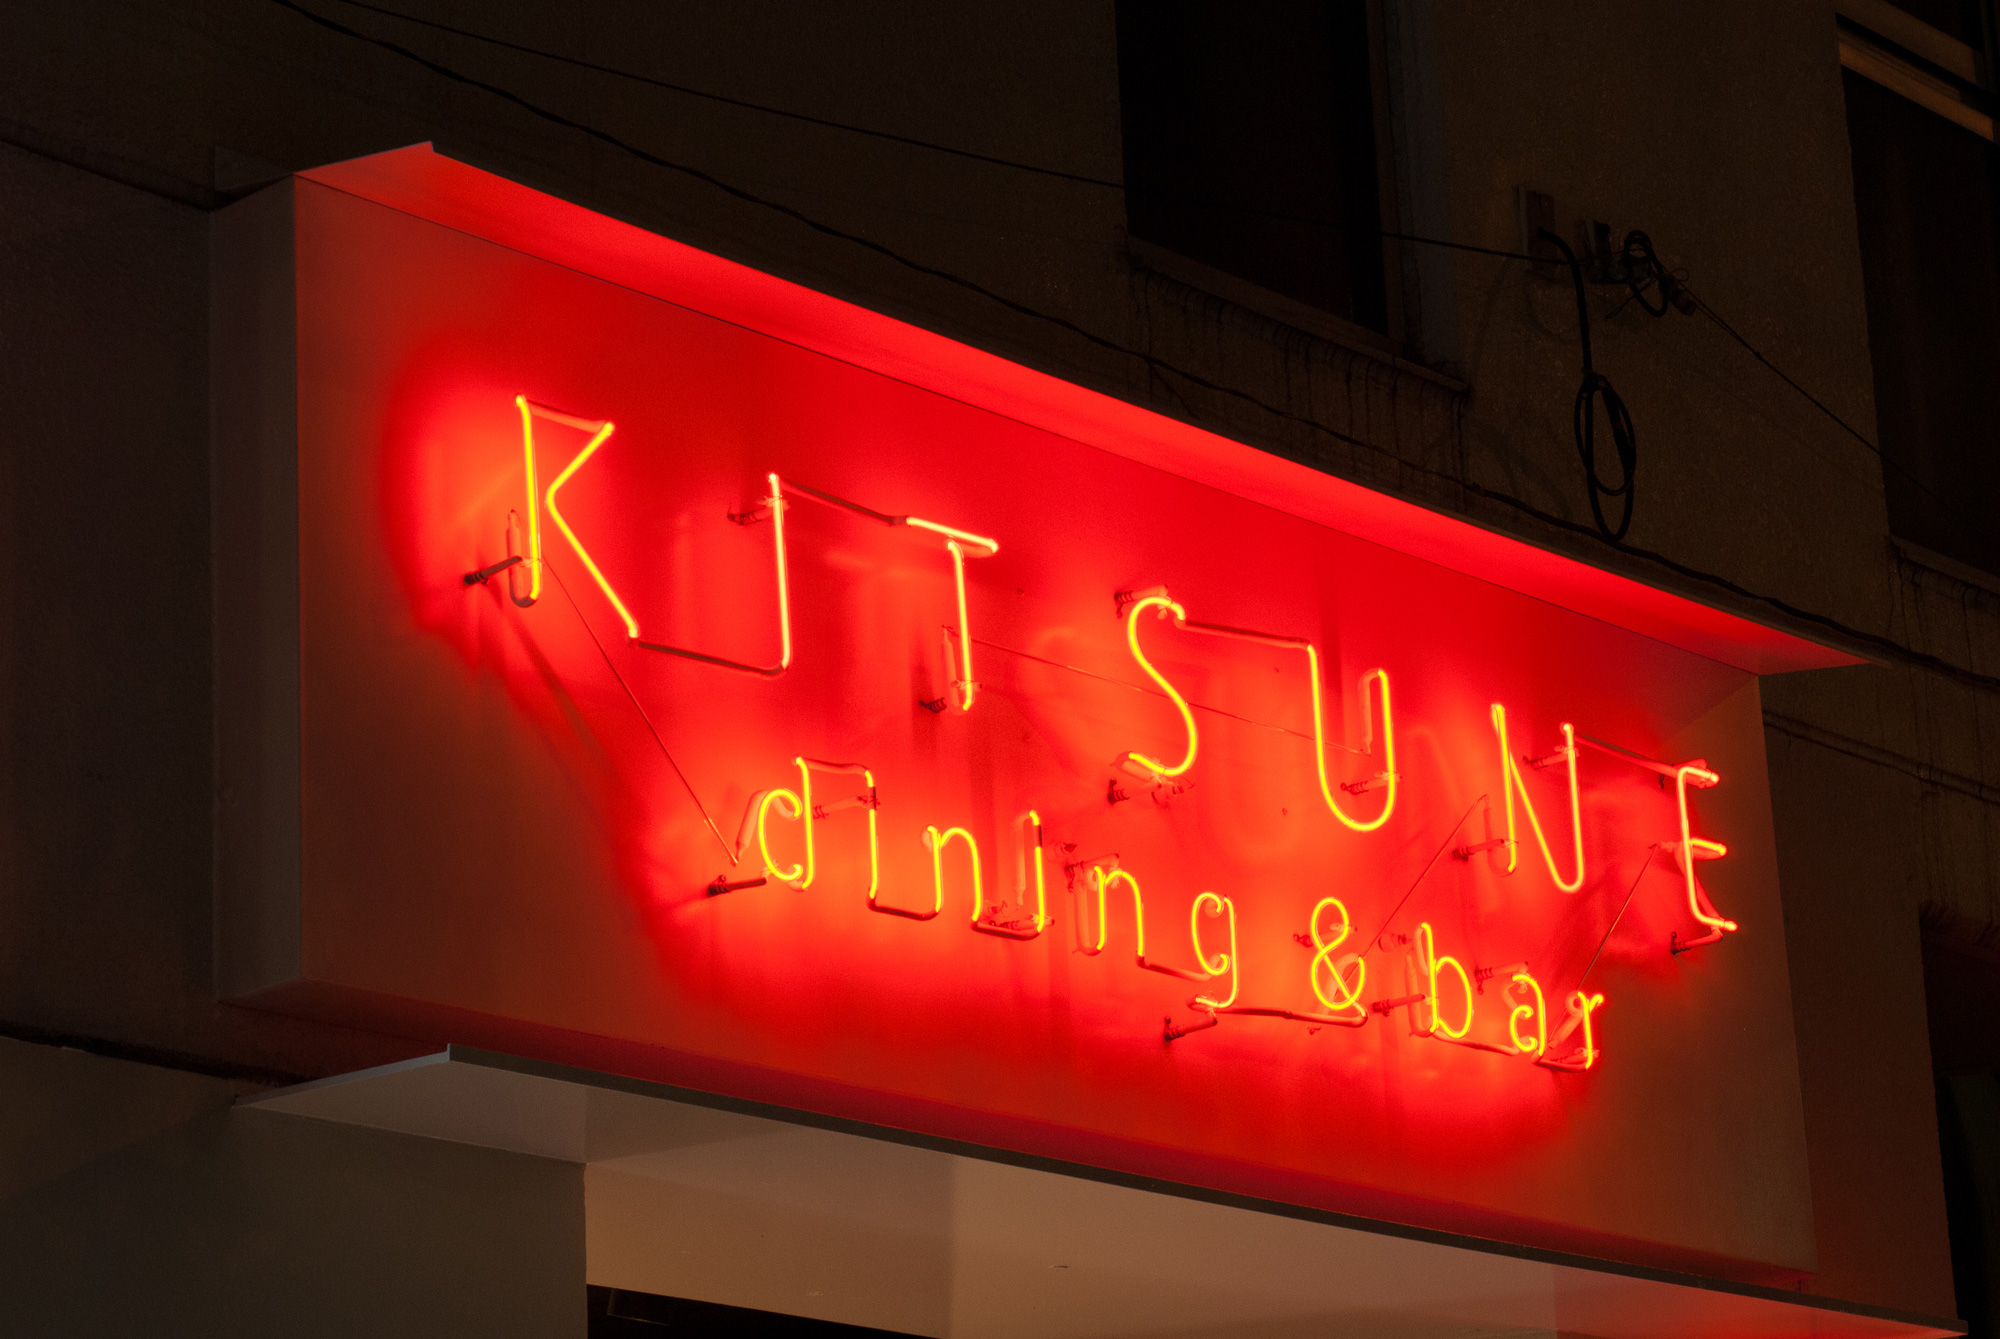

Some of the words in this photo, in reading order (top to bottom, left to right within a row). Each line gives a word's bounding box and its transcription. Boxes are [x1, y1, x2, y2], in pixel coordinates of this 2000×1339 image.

[514, 394, 1738, 931] KITSUNE
[757, 755, 1239, 1009] dining
[1311, 896, 1369, 1020] &
[1413, 921, 1604, 1069] bar
